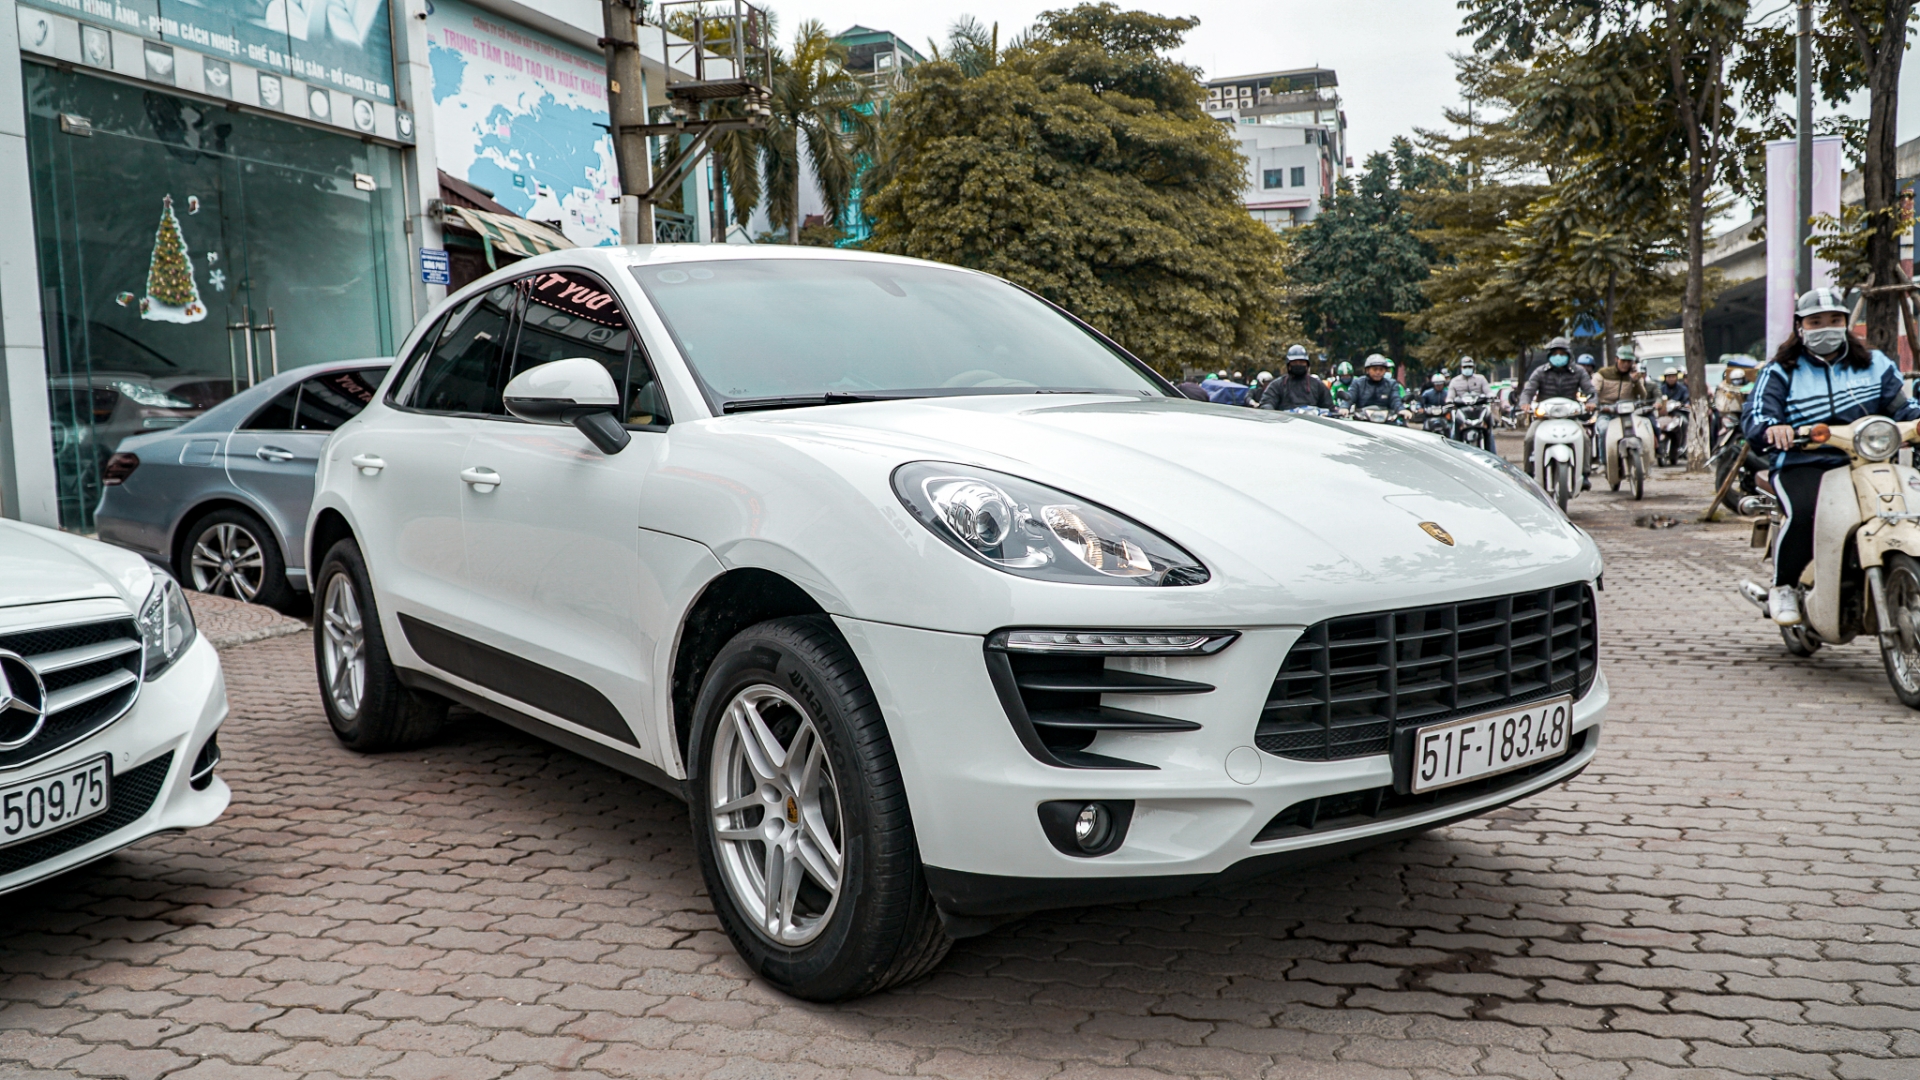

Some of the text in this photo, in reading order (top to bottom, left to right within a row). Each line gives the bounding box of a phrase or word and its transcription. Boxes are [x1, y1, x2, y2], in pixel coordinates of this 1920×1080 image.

[148, 14, 180, 37] PHIM
[180, 22, 209, 46] CÁCH
[210, 32, 240, 56] NHIỆT
[247, 43, 268, 63] GHẾ
[268, 49, 283, 68] DA
[305, 59, 325, 80] SÀN
[364, 78, 376, 95] XE
[443, 27, 478, 56] TRUNG
[480, 40, 501, 65] TÂM
[503, 50, 523, 72] ĐÀO
[524, 57, 542, 80] TẠO
[543, 63, 556, 83] VÀ
[1421, 705, 1566, 782] 51F-183.48
[3, 765, 103, 836] 509.75
